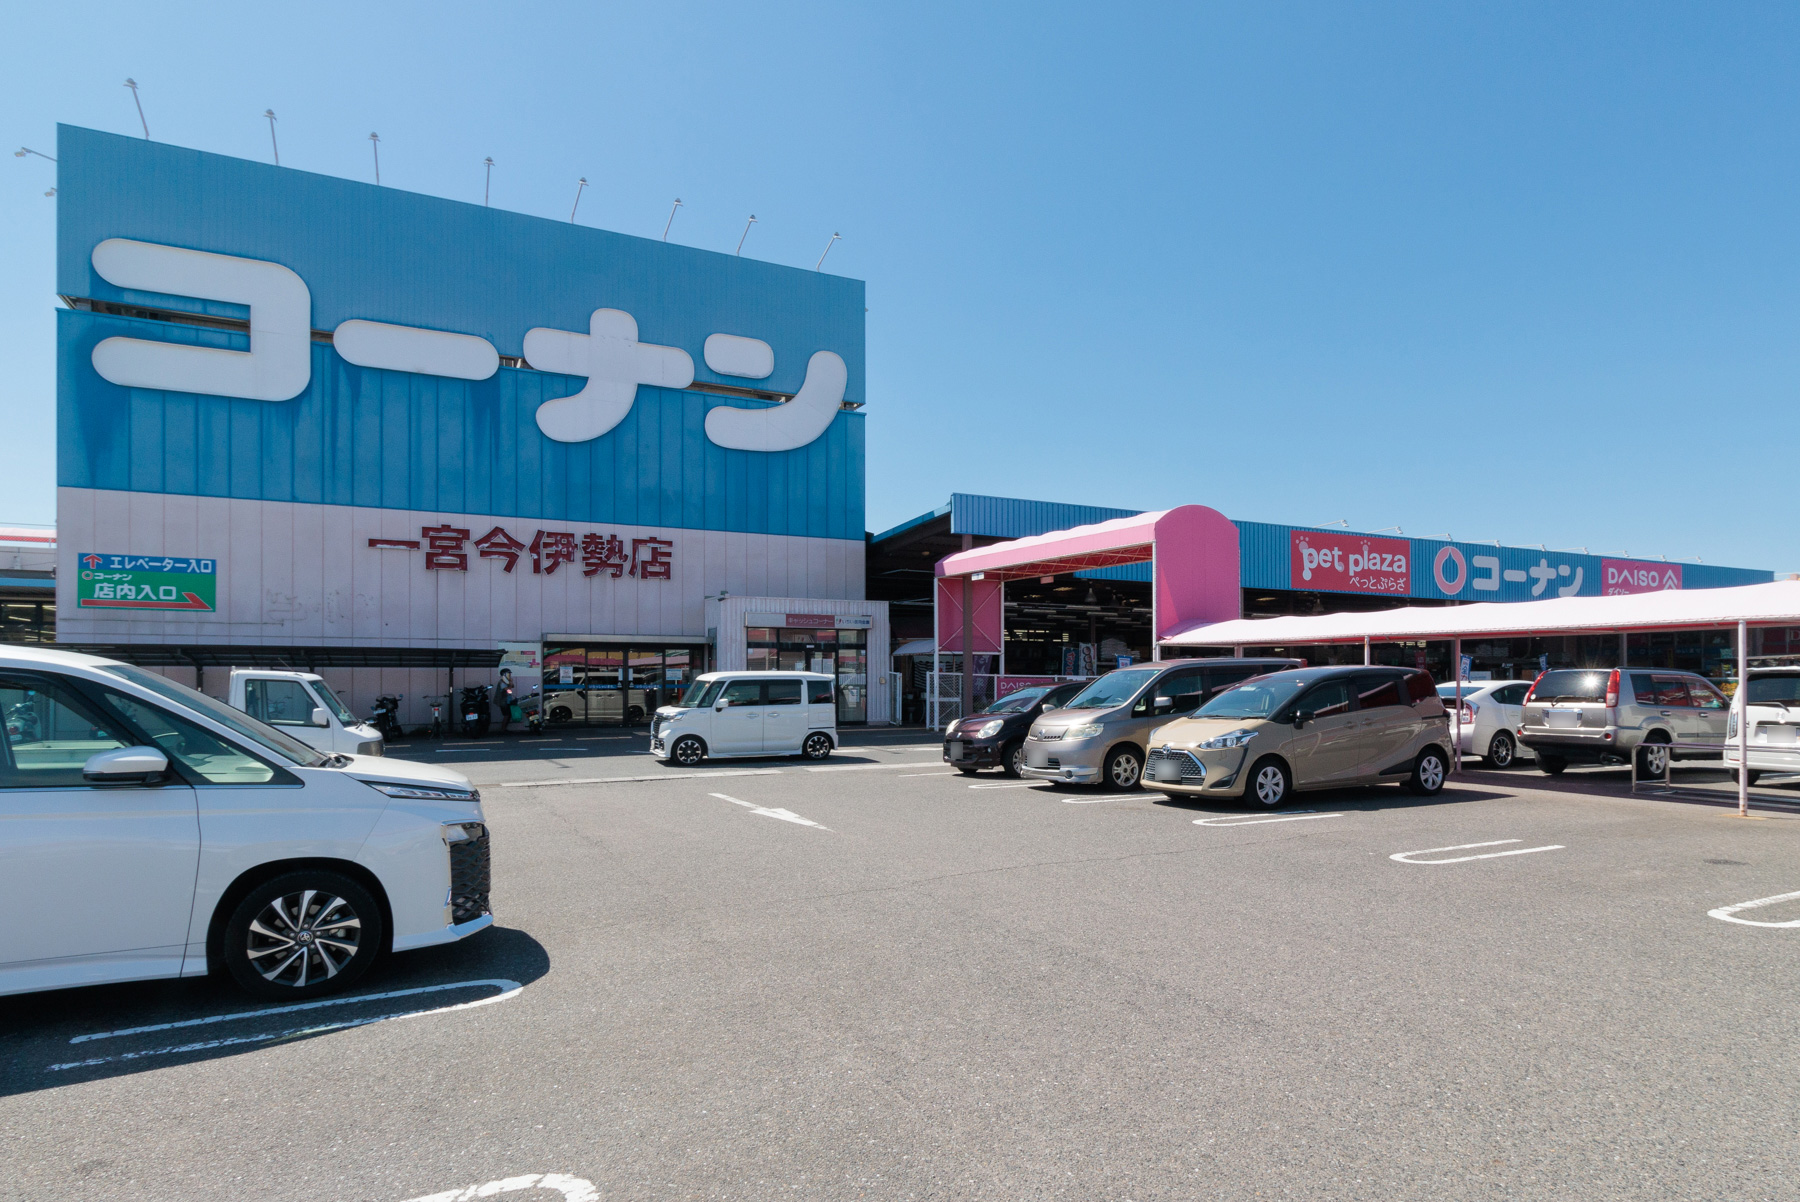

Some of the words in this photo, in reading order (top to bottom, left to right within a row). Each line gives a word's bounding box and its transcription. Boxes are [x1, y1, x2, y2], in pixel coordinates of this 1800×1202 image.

[92, 237, 848, 452] コーナン
[368, 524, 674, 580] 一宮今伊勢店
[110, 556, 212, 574] エレベーター入口
[1301, 546, 1344, 581] pet
[1348, 549, 1406, 577] plaza
[94, 572, 133, 581] コーナン
[1349, 576, 1406, 592] ぺっとぷらざ
[1472, 555, 1584, 598] コーナン
[1608, 567, 1660, 587] DAISO
[93, 583, 177, 600] 店内入口
[788, 617, 834, 625] キャッシュコーナー
